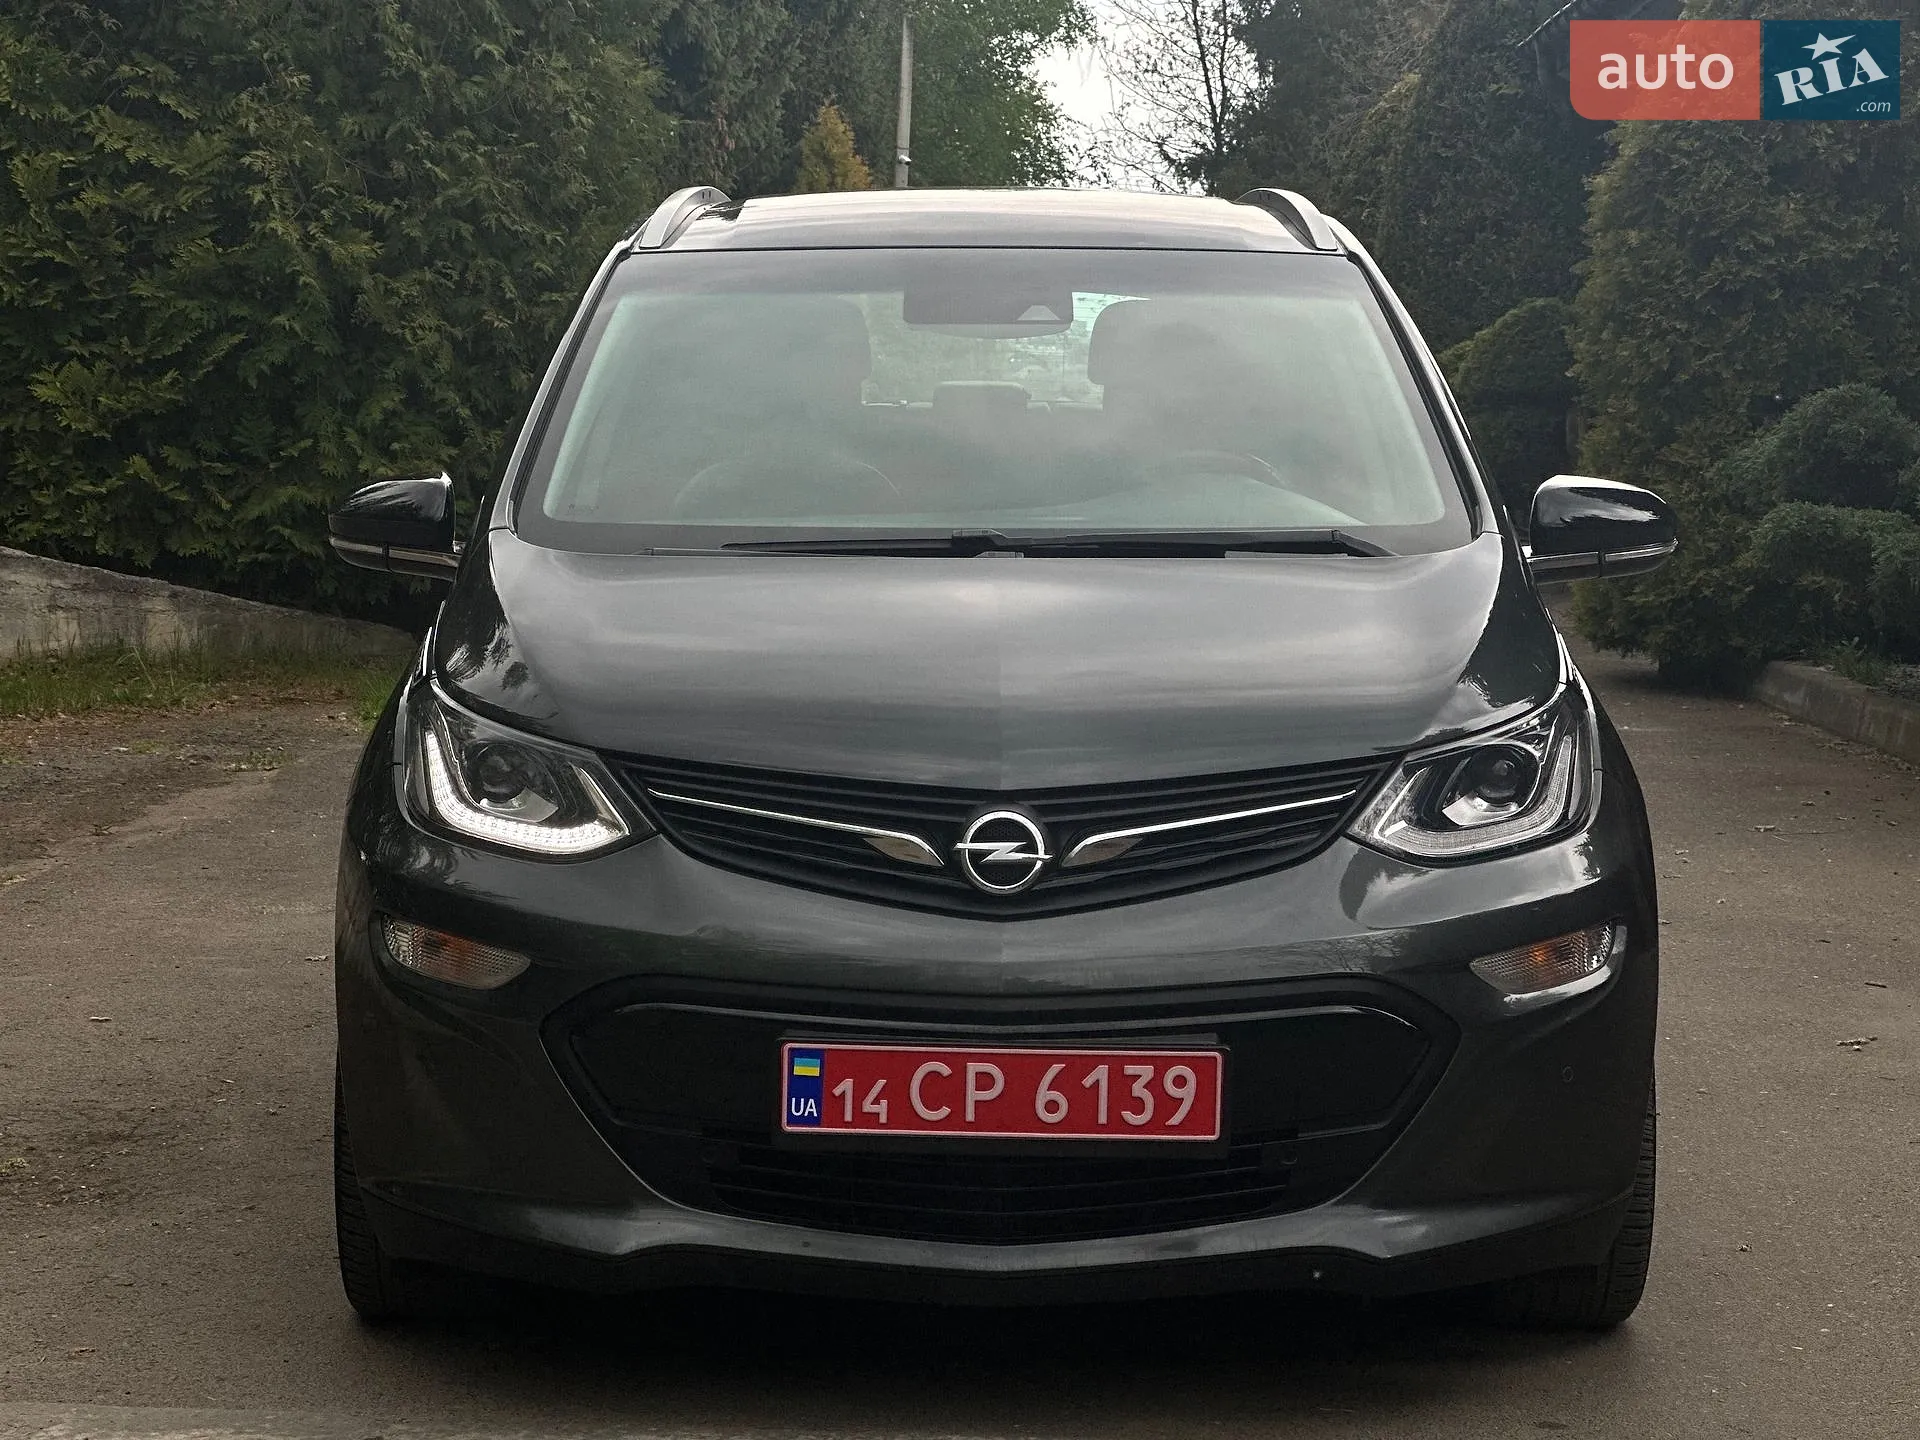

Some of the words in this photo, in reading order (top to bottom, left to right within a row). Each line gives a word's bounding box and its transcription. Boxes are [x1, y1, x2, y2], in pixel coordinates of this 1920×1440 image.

[791, 1097, 818, 1117] UA
[832, 1078, 888, 1124] 14
[909, 1061, 1005, 1122] CP
[1035, 1063, 1197, 1126] 6139
